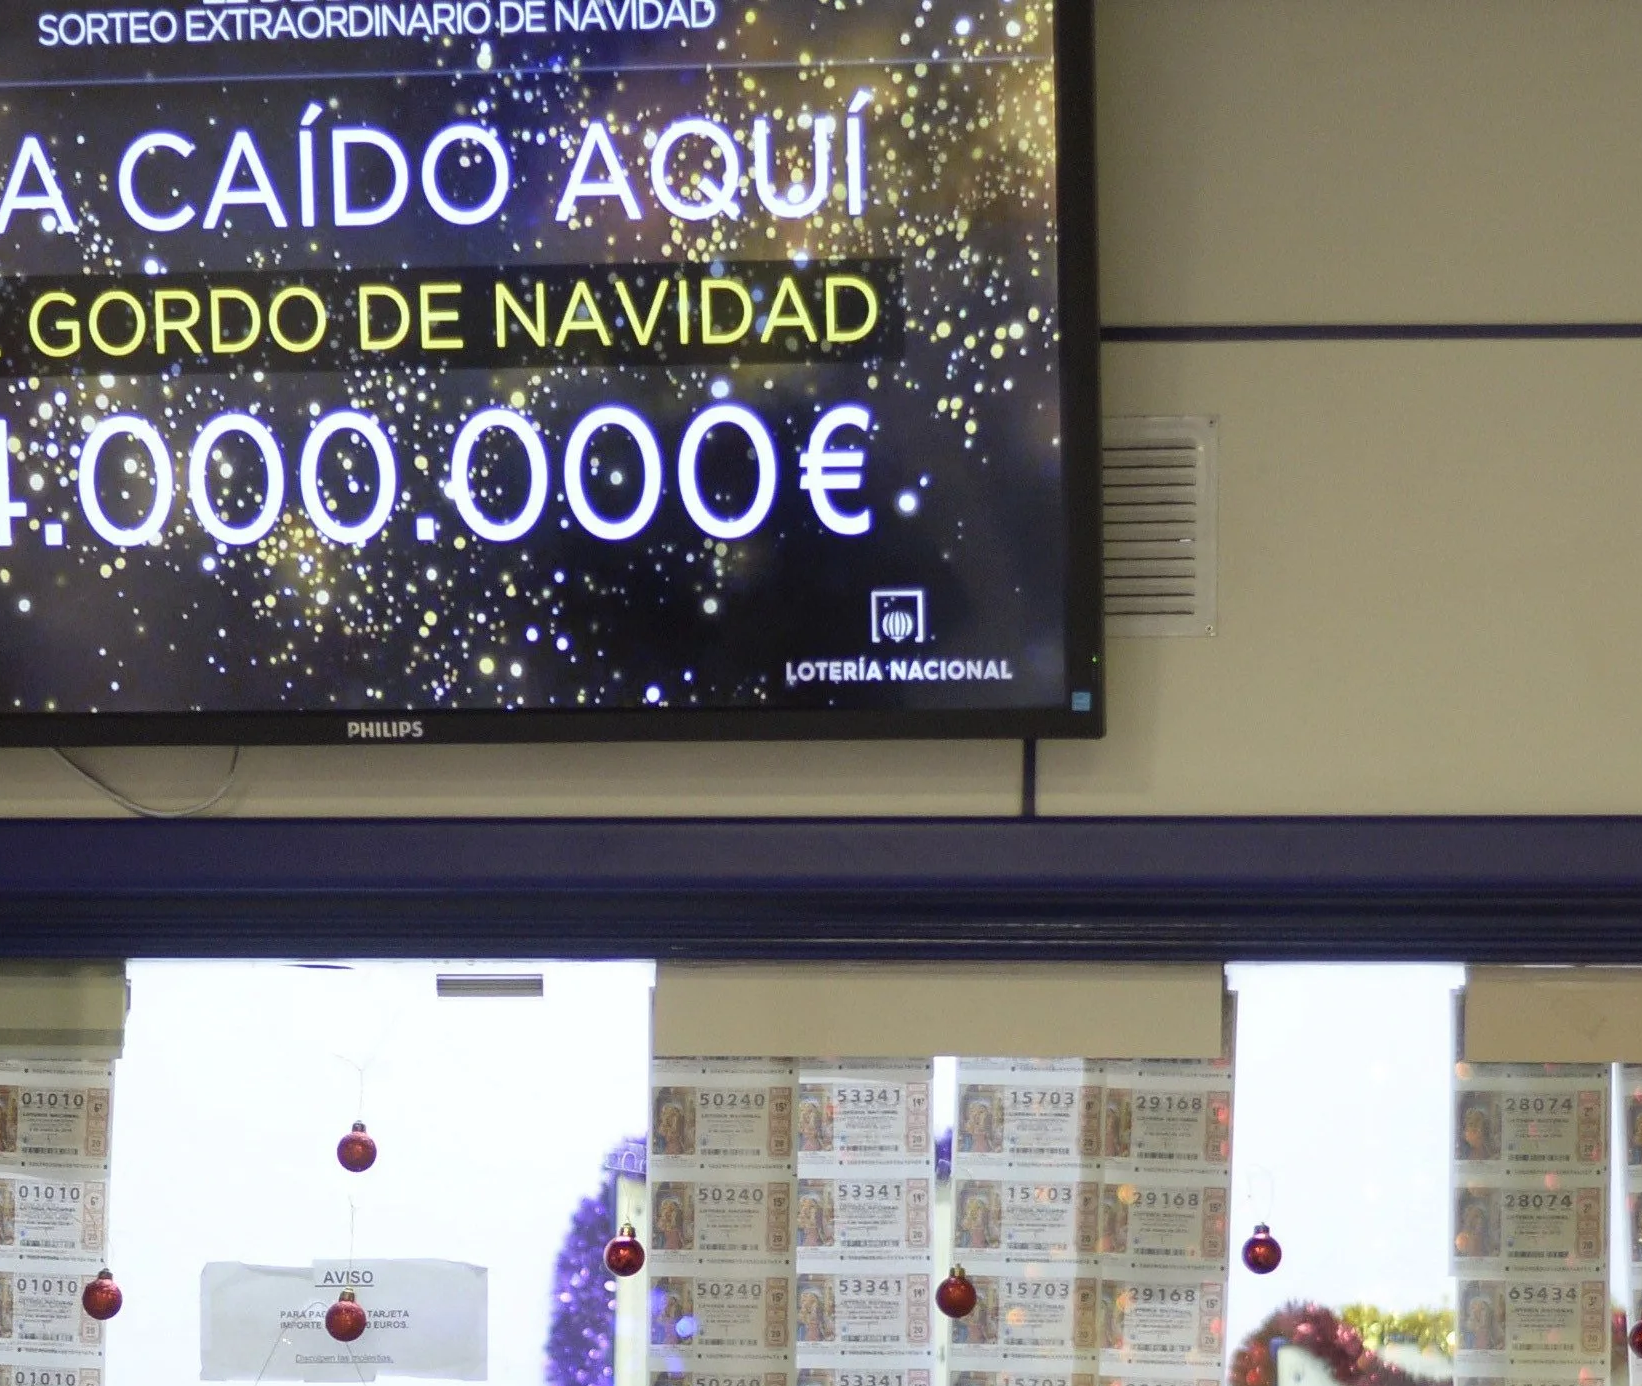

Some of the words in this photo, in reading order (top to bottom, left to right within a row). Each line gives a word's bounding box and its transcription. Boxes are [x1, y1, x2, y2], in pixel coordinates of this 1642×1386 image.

[38, 13, 177, 46] SORTEO
[186, 4, 492, 42] EXTRAORDINARIO
[499, 3, 546, 34] DE
[555, 0, 716, 31] NAVIDAD
[117, 104, 510, 231] CAÍDO
[557, 90, 871, 225] AQUÍ
[28, 288, 328, 357] GORDO
[358, 284, 463, 351] DE
[495, 277, 879, 349] NAVIDAD
[786, 655, 883, 681] LOTERÍA
[890, 661, 1012, 680] NACIONAL
[348, 721, 423, 739] PHILIPS
[22, 1093, 84, 1108] 01010
[699, 1093, 765, 1108] 50240
[837, 1088, 902, 1104] 53341
[1010, 1091, 1075, 1107] 15703
[1136, 1095, 1202, 1111] 29168
[1505, 1098, 1573, 1113] 28074
[323, 1270, 374, 1284] AVISO
[280, 1310, 306, 1318] PARA
[369, 1310, 409, 1318] TARJETA
[280, 1321, 322, 1329] IMPORTE
